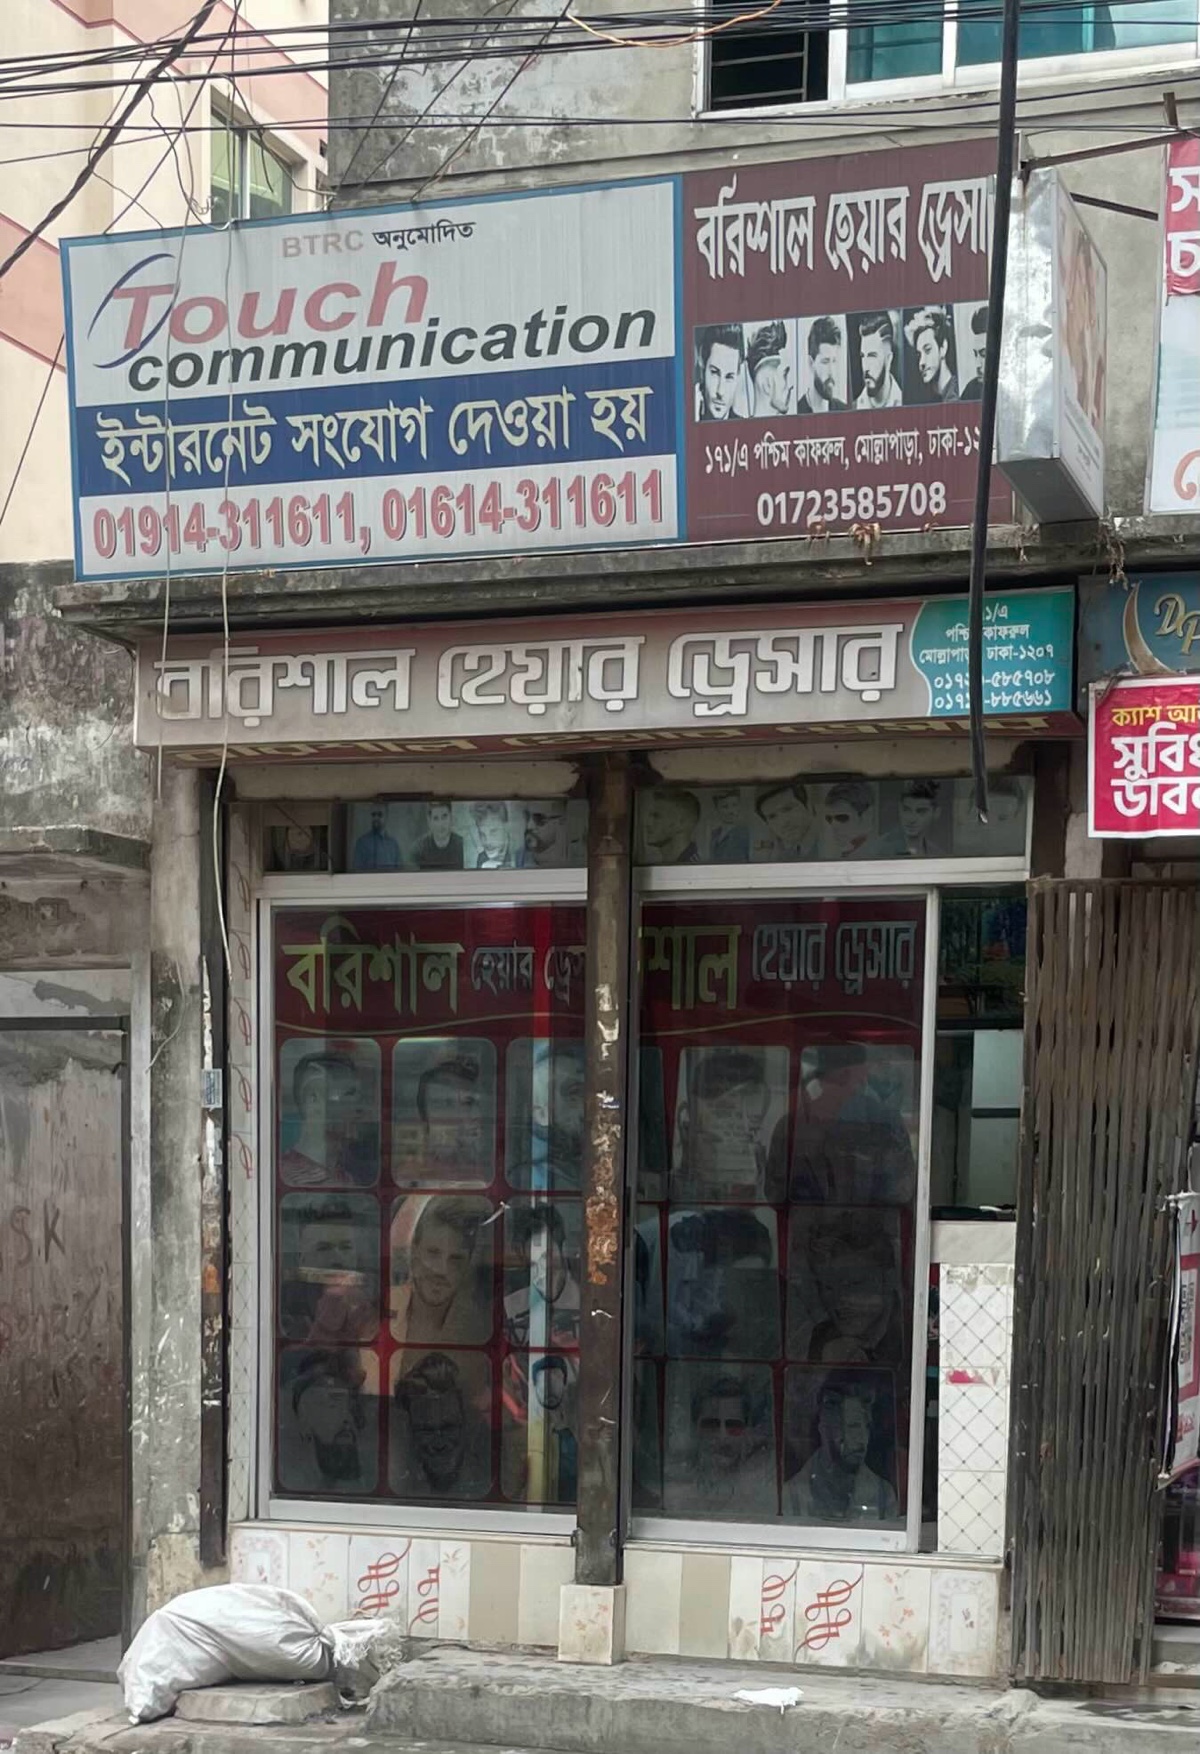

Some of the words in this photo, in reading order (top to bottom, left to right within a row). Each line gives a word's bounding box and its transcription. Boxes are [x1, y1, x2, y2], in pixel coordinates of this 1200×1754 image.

[281, 229, 364, 259] BTRC
[372, 218, 477, 252] অনুমোদিত
[694, 173, 816, 280] বরিশাল
[824, 186, 910, 282] হেয়ার
[917, 177, 987, 284] ড্রেসা
[113, 260, 430, 350] Touch
[128, 304, 657, 392] communication
[96, 399, 278, 487] ইন্টারনেট
[285, 396, 435, 471] সংযোগ
[448, 384, 577, 456] দেওয়া
[584, 386, 655, 452] হয়
[705, 438, 749, 478] ১৭১/এ
[753, 430, 791, 470] পশ্চিম
[93, 490, 371, 560] 01914-311611,
[382, 469, 663, 542] 01614-311611
[757, 481, 948, 527] 01723585708
[153, 646, 416, 728] বরিশাল
[436, 635, 646, 716] হেয়ার
[666, 622, 905, 717] ড্রেসার
[945, 622, 970, 643] পশ্চি
[1111, 705, 1163, 727] ক্যাশ
[1166, 704, 1200, 724] আ
[281, 915, 465, 1015] বরিশাল
[752, 923, 829, 991] হেয়ার
[835, 920, 918, 995] ড্রেসার
